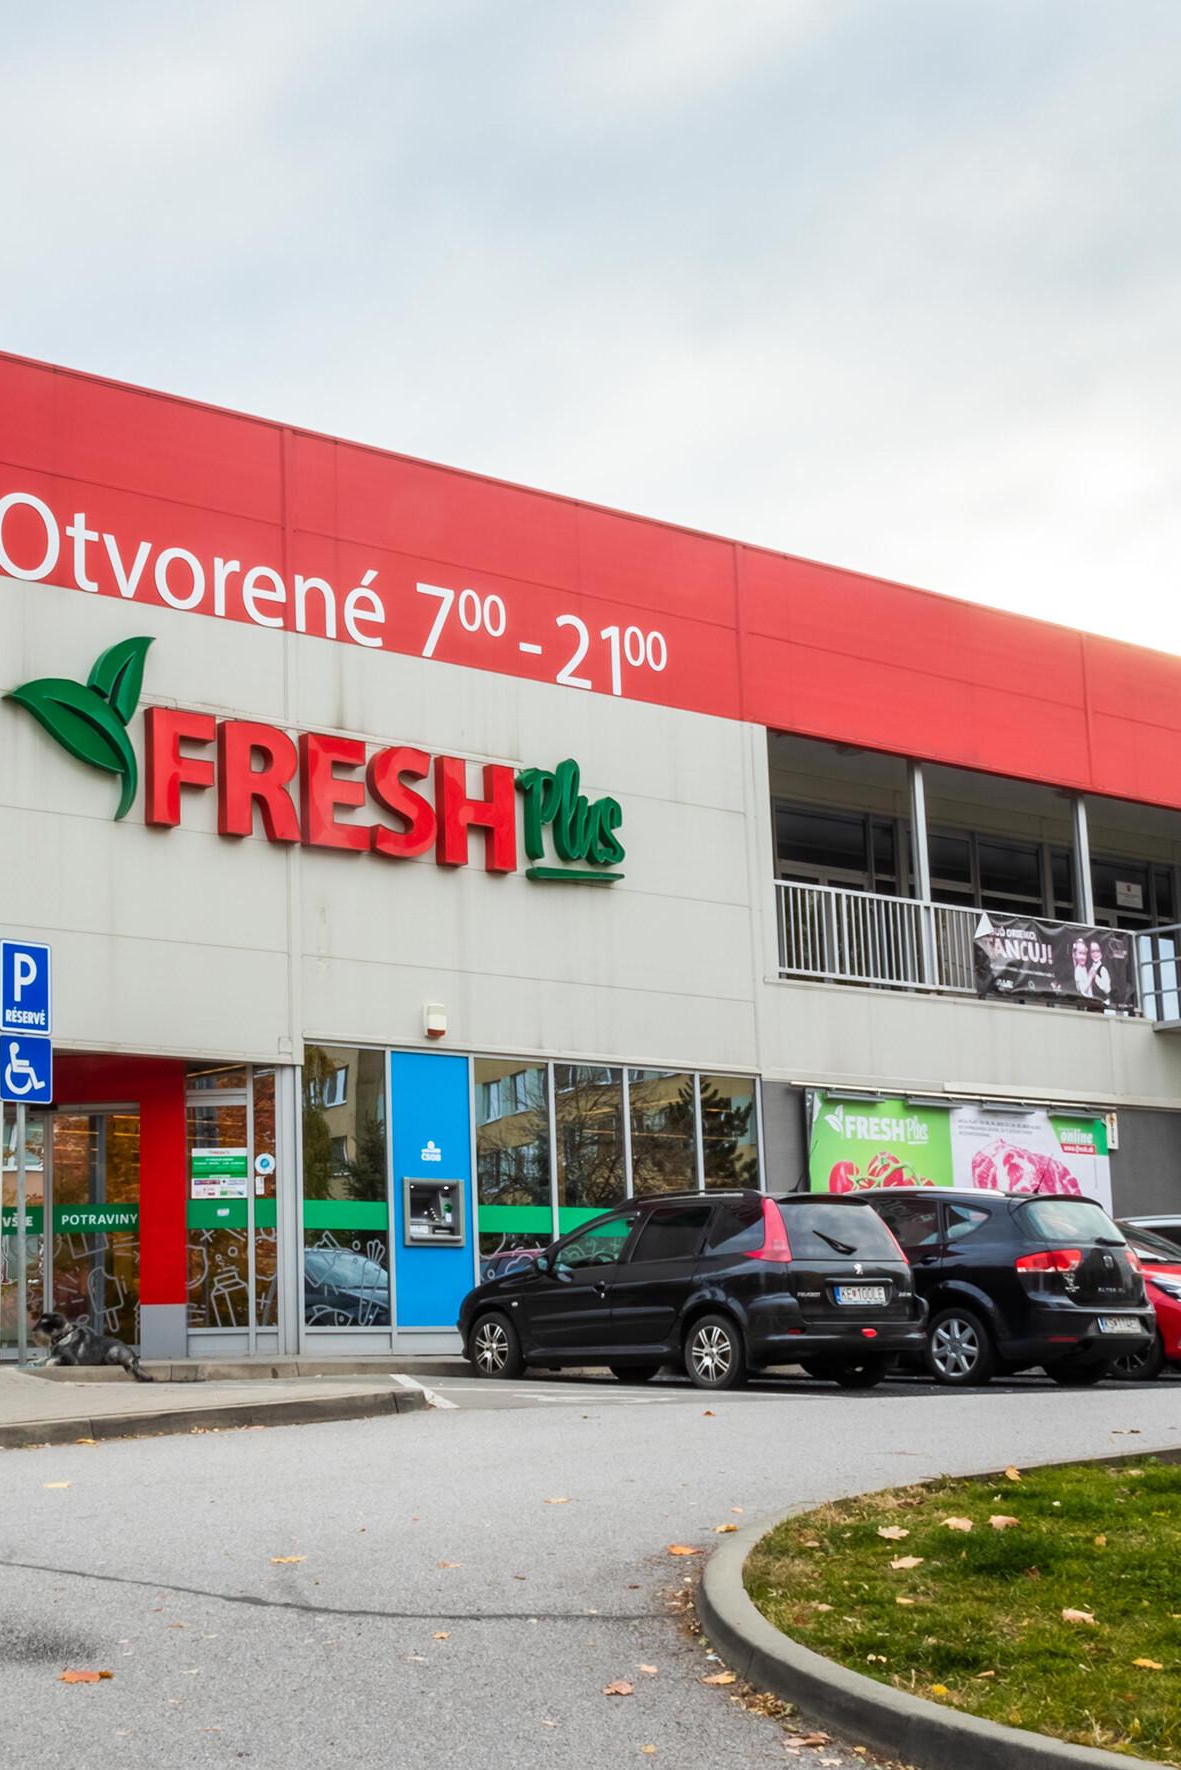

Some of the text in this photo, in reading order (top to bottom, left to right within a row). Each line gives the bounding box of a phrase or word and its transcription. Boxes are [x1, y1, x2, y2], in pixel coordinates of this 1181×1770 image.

[144, 705, 517, 874] FRESH
[13, 952, 38, 1002] P
[5, 1006, 46, 1026] RÉSERVÉ
[845, 1114, 905, 1142] FRESH
[61, 1213, 138, 1226] POTRAVINY
